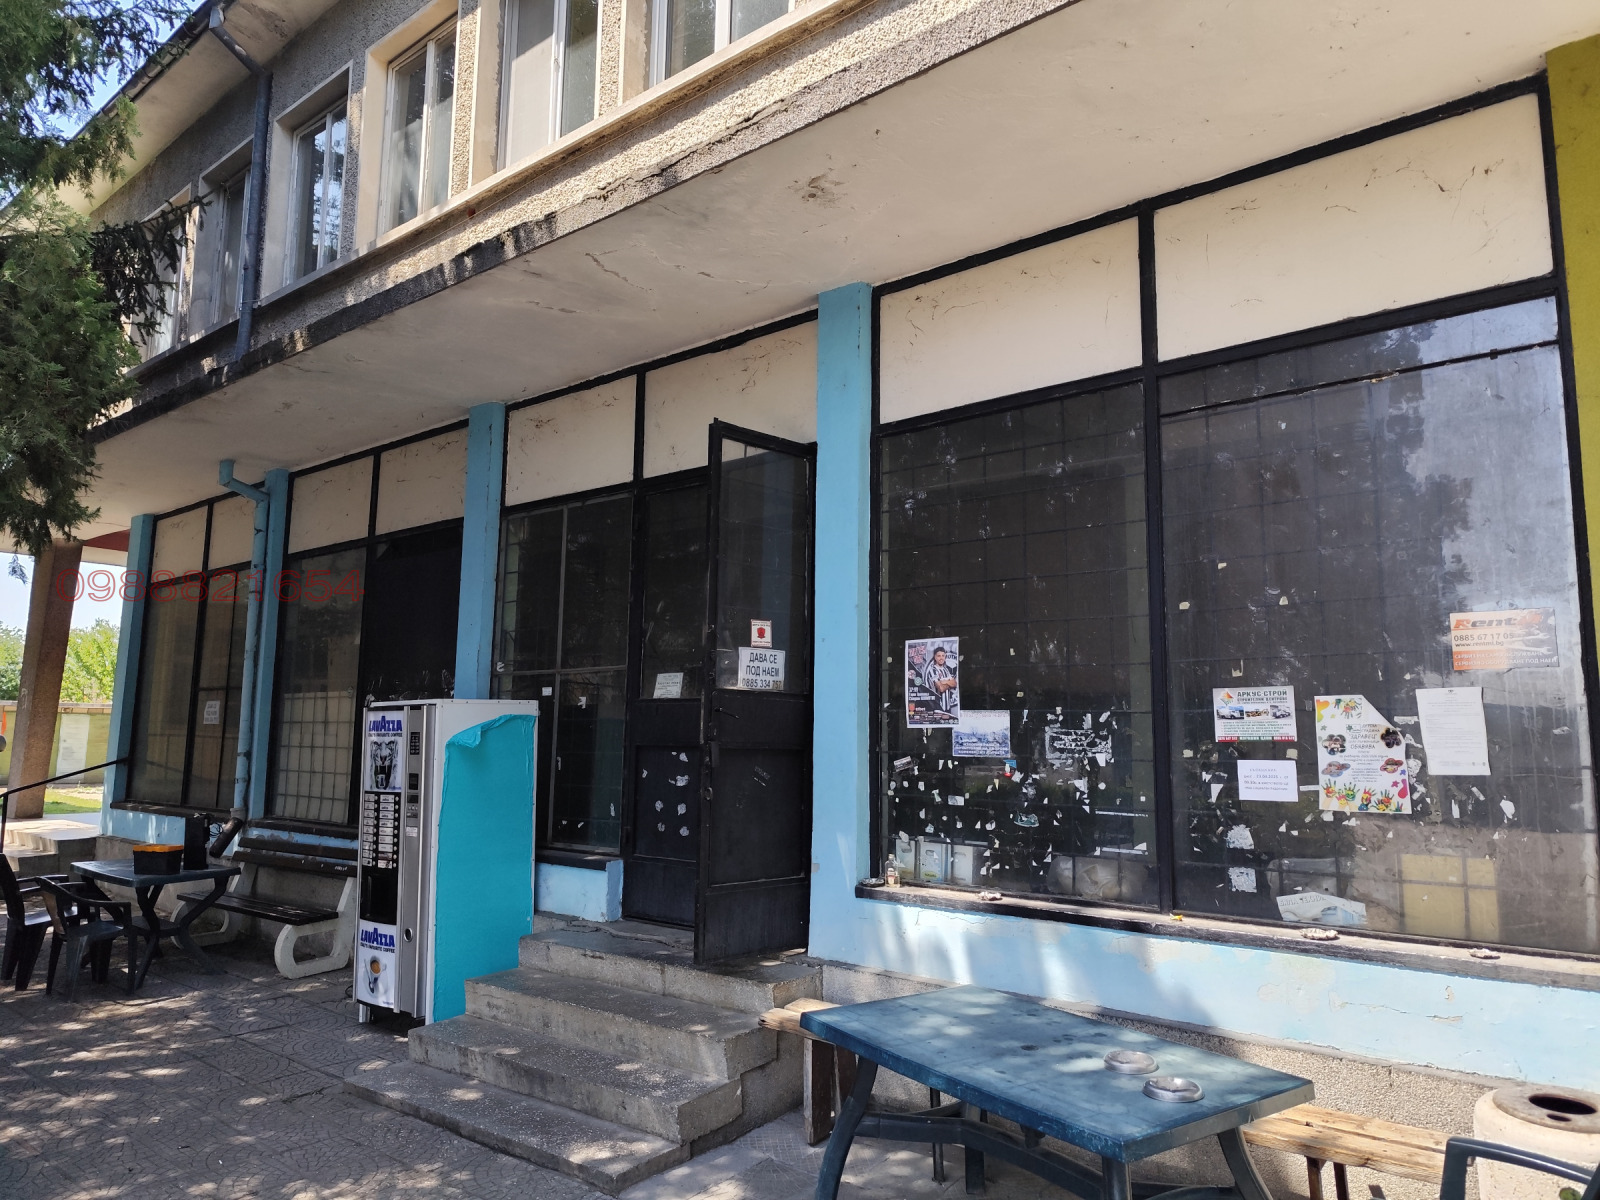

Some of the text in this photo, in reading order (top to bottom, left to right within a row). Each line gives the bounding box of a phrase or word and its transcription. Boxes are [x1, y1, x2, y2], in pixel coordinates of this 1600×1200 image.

[1454, 634, 1475, 642] 0885
[1478, 633, 1488, 641] 67
[1491, 632, 1501, 640] 17
[749, 652, 778, 664] ДАВА СЕ
[746, 665, 780, 677] ПОД НАЕМ
[742, 678, 758, 688] 0885
[760, 679, 771, 688] 334
[369, 716, 402, 732] LAVAZZA
[361, 928, 395, 947] LAVAZZA
